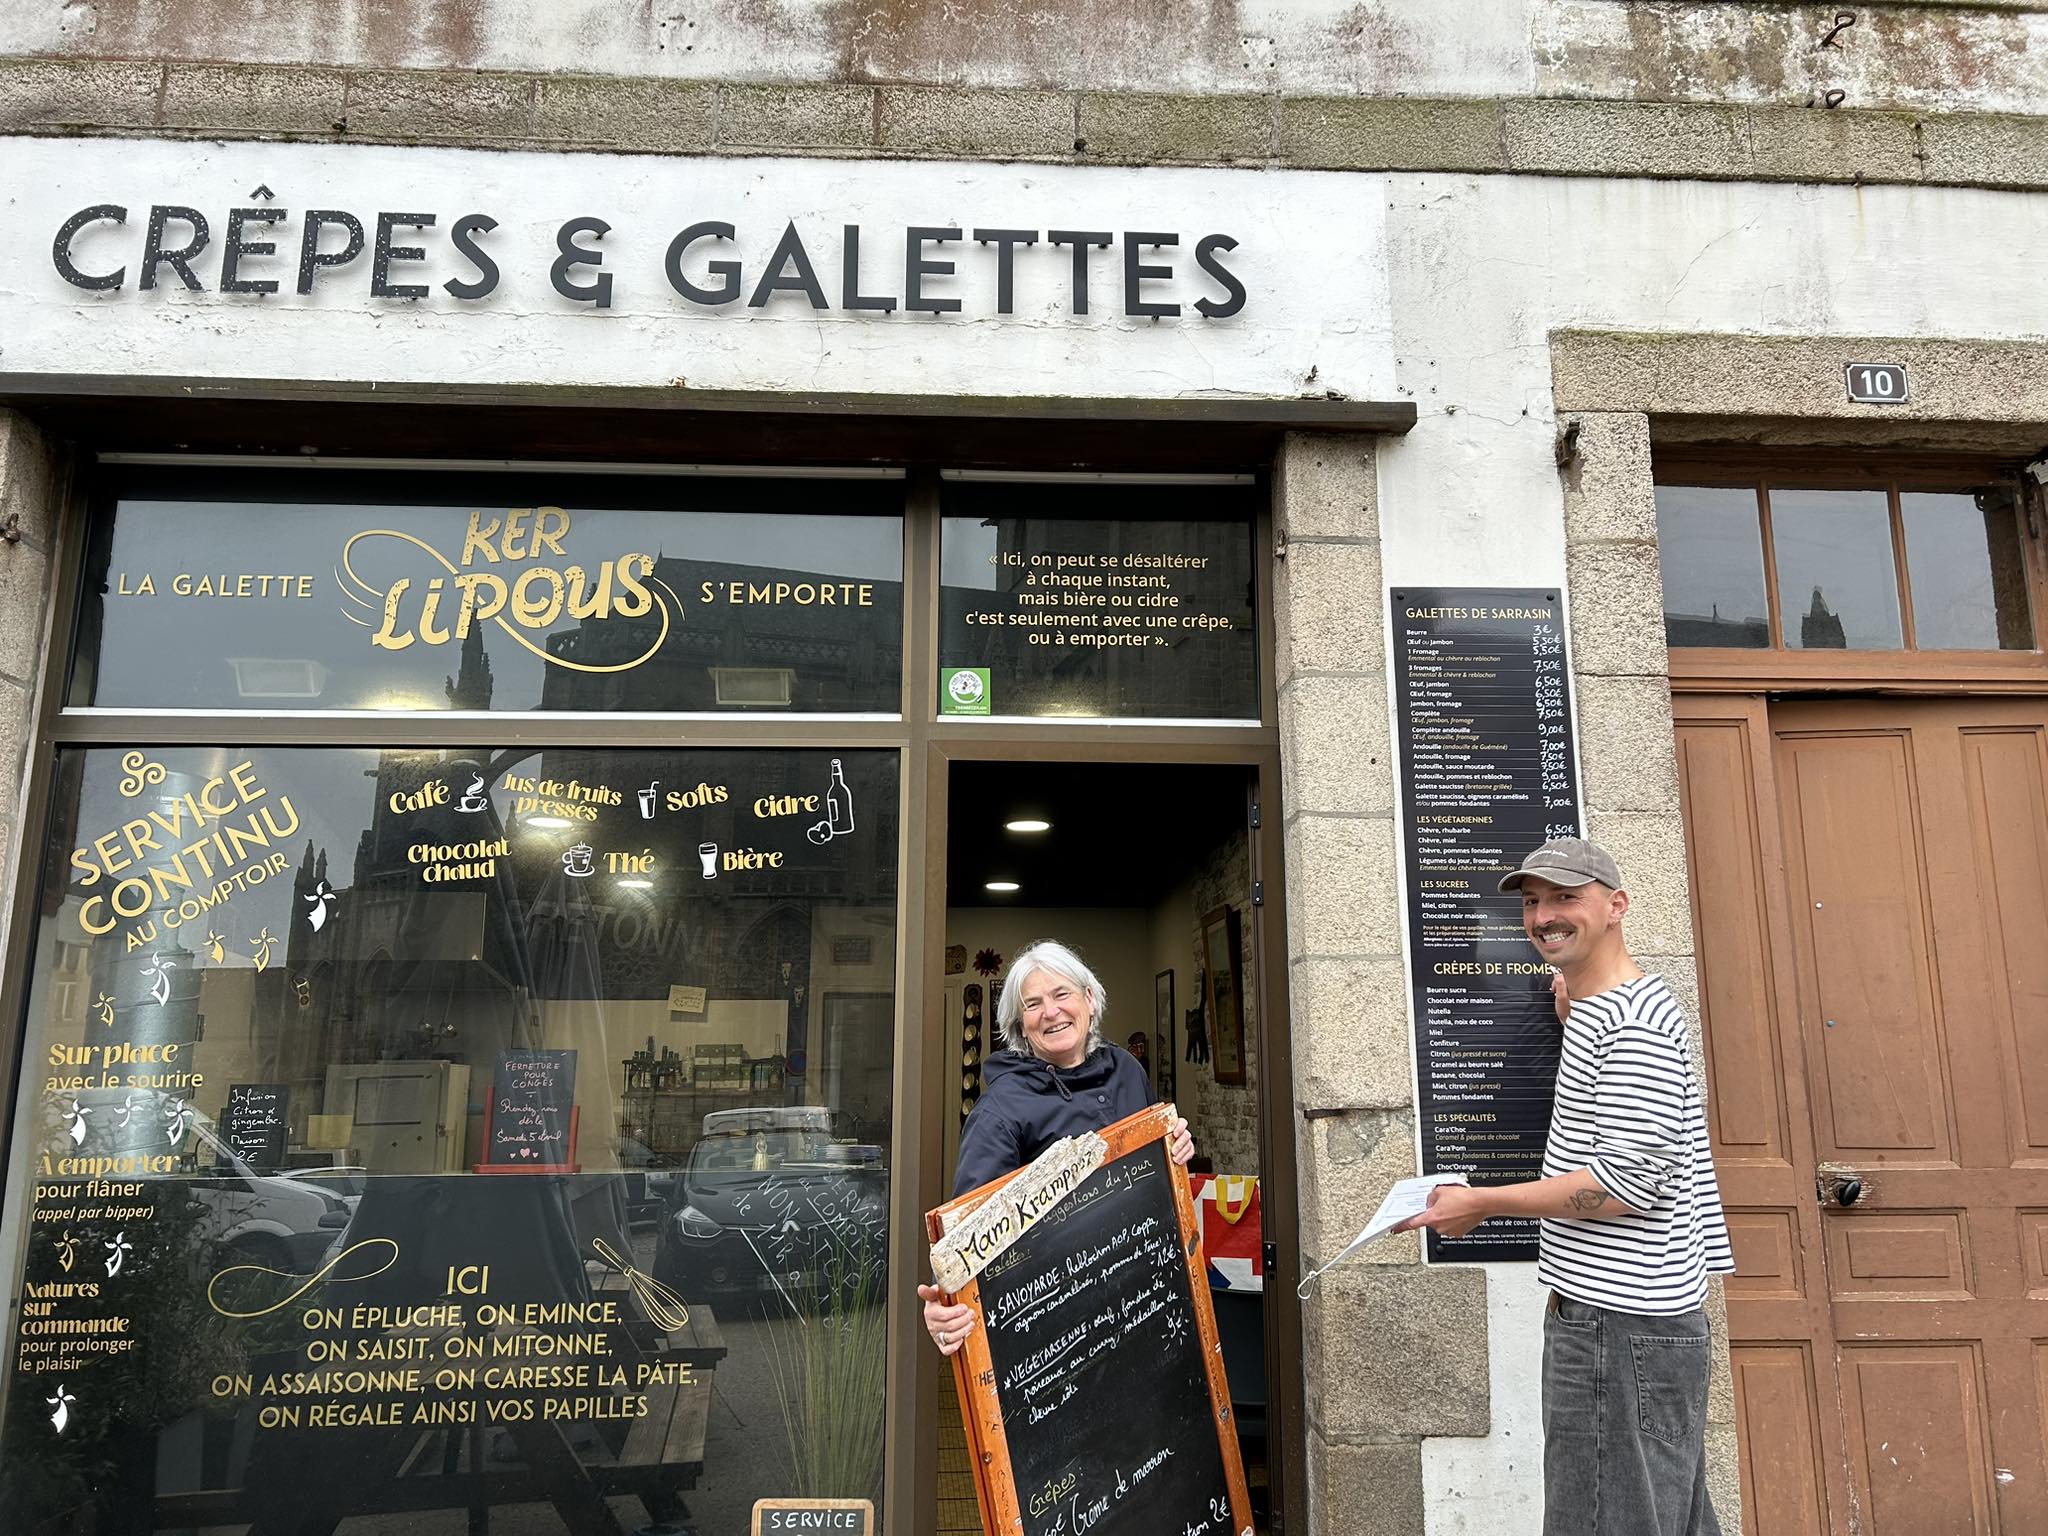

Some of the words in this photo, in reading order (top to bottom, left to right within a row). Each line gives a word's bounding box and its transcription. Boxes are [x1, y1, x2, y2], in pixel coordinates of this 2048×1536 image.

[52, 183, 500, 301] CRÊPES
[550, 216, 614, 307] &
[665, 219, 1247, 318] GALETTES
[1861, 370, 1893, 396] 10
[461, 506, 571, 566] KER
[1003, 552, 1026, 568] Ici,
[1030, 555, 1052, 566] on
[1057, 554, 1095, 570] peut
[1100, 556, 1118, 567] se
[1123, 553, 1208, 568] désaltérer
[118, 574, 156, 597] LA
[173, 573, 315, 599] GALETTE
[1026, 571, 1036, 585] à
[1041, 571, 1102, 589] chaque
[1107, 573, 1171, 589] instant,
[701, 580, 874, 606] S'EMPORTE
[1019, 591, 1058, 606] mais
[1063, 591, 1106, 606] bière
[1111, 595, 1132, 607] ou
[1137, 592, 1179, 607] cidre
[965, 612, 1004, 625] c'est
[1009, 612, 1098, 627] seulement
[1102, 615, 1141, 627] avec
[1145, 616, 1177, 627] une
[1182, 613, 1233, 631] crêpe,
[1405, 607, 1468, 619] GALETTES
[1471, 608, 1488, 619] DE
[1491, 608, 1552, 619] SARRASIN
[1533, 624, 1553, 636] 3€
[1028, 633, 1050, 645] ou
[1055, 631, 1065, 645] à
[1070, 633, 1150, 649] emporter
[1532, 644, 1563, 657] 5,50€
[1413, 664, 1442, 672] fromages
[1532, 659, 1562, 674] 7,50€
[1535, 675, 1563, 690] 6,50€
[1426, 690, 1453, 698] fromage
[1535, 688, 1563, 700] 6,50€
[1535, 698, 1564, 708] 6,50€
[1536, 706, 1565, 720] 7,50€
[1538, 723, 1567, 737] 9,00€
[1540, 739, 1567, 753] 7,00€
[502, 773, 537, 793] Jus
[538, 778, 565, 797] de
[565, 780, 623, 806] fruits
[1542, 781, 1570, 792] 6,50€
[389, 779, 451, 814] Café
[666, 782, 729, 812] Softs
[753, 793, 820, 818] Cidre
[1543, 796, 1573, 809] 7,00€
[517, 795, 598, 821] pressés
[70, 760, 267, 886] SERVICE
[1416, 815, 1430, 823] LES
[1545, 823, 1576, 836] 6,50€
[79, 795, 300, 935] CONTINU
[602, 847, 655, 874] Thé
[723, 847, 784, 871] Bière
[422, 859, 495, 883] chaud
[1420, 880, 1434, 888] LES
[126, 920, 158, 953] AU
[162, 852, 291, 929] COMPTOIR
[1433, 960, 1482, 975] CRÊPES
[1486, 963, 1503, 975] DE
[1506, 963, 1553, 975] FROME
[49, 1043, 99, 1066] Sur
[102, 1042, 179, 1069] place
[505, 1060, 560, 1071] FERMETURE
[46, 1076, 95, 1090] avec
[101, 1071, 120, 1088] le
[127, 1070, 204, 1088] sourire
[524, 1071, 547, 1079] POUR
[231, 1088, 277, 1105] Infusion
[233, 1106, 263, 1115] Citron
[1434, 1114, 1448, 1122] LES
[1449, 1113, 1497, 1122] SPÉCIALITÉS
[529, 1132, 538, 1142] 5
[57, 1151, 181, 1178] emporter
[35, 1184, 81, 1203] pour
[86, 1180, 144, 1198] flâner
[32, 1207, 76, 1223] (appel
[77, 1209, 102, 1222] par
[105, 1205, 154, 1222] bipper)
[25, 1280, 100, 1298] Natures
[447, 1265, 489, 1295] ICI
[23, 1302, 58, 1317] sur
[303, 1307, 344, 1330] ON
[352, 1302, 467, 1329] ÉPLUCHE,
[476, 1303, 516, 1326] ON
[524, 1301, 622, 1325] EMINCE,
[20, 1316, 130, 1336] commande
[20, 1341, 56, 1356] pour
[60, 1337, 135, 1355] prolonger
[307, 1339, 348, 1362] ON
[356, 1337, 435, 1361] SAISIT,
[444, 1336, 484, 1358] ON
[492, 1333, 613, 1357] MITONNE,
[18, 1357, 32, 1371] le
[35, 1355, 82, 1375] plaisir
[211, 1374, 253, 1397] ON
[260, 1369, 426, 1396] ASSAISONNE,
[435, 1368, 475, 1391] ON
[484, 1364, 589, 1390] CARESSE
[598, 1364, 628, 1386] LA
[636, 1358, 698, 1387] PÂTE,
[259, 1405, 300, 1428] ON
[309, 1399, 404, 1428] RÉGALE
[412, 1400, 476, 1424] AINSI
[486, 1398, 534, 1422] VOS
[543, 1395, 649, 1420] PAPILLES
